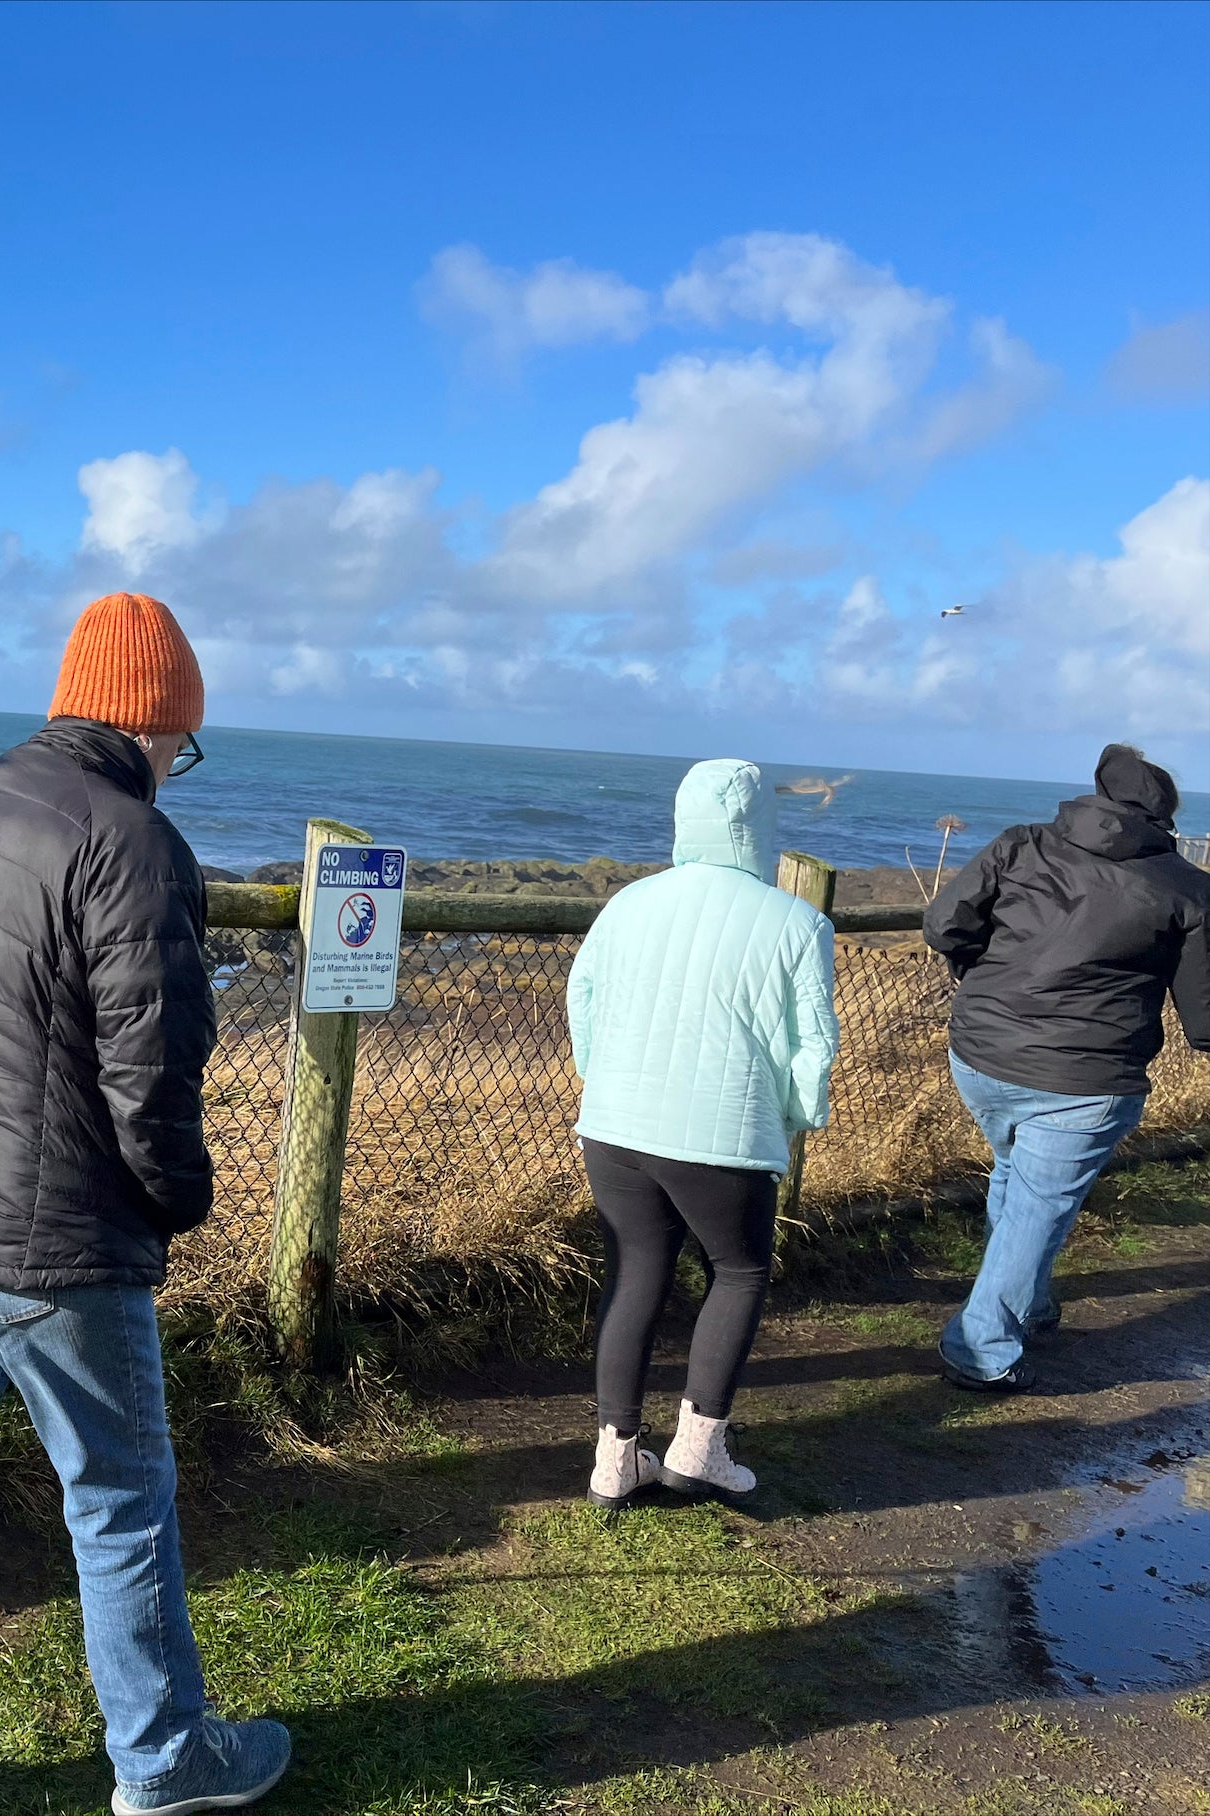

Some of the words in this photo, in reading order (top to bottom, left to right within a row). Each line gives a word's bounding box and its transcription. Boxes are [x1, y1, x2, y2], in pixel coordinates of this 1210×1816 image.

[321, 851, 340, 867] NO
[320, 870, 379, 886] CLIMBING
[312, 952, 348, 962] Disturbing
[351, 952, 374, 960] Marine
[375, 951, 393, 960] Birds
[312, 965, 325, 973] and
[327, 964, 361, 972] Mammals
[362, 964, 369, 972] is
[370, 963, 392, 973] Illegal
